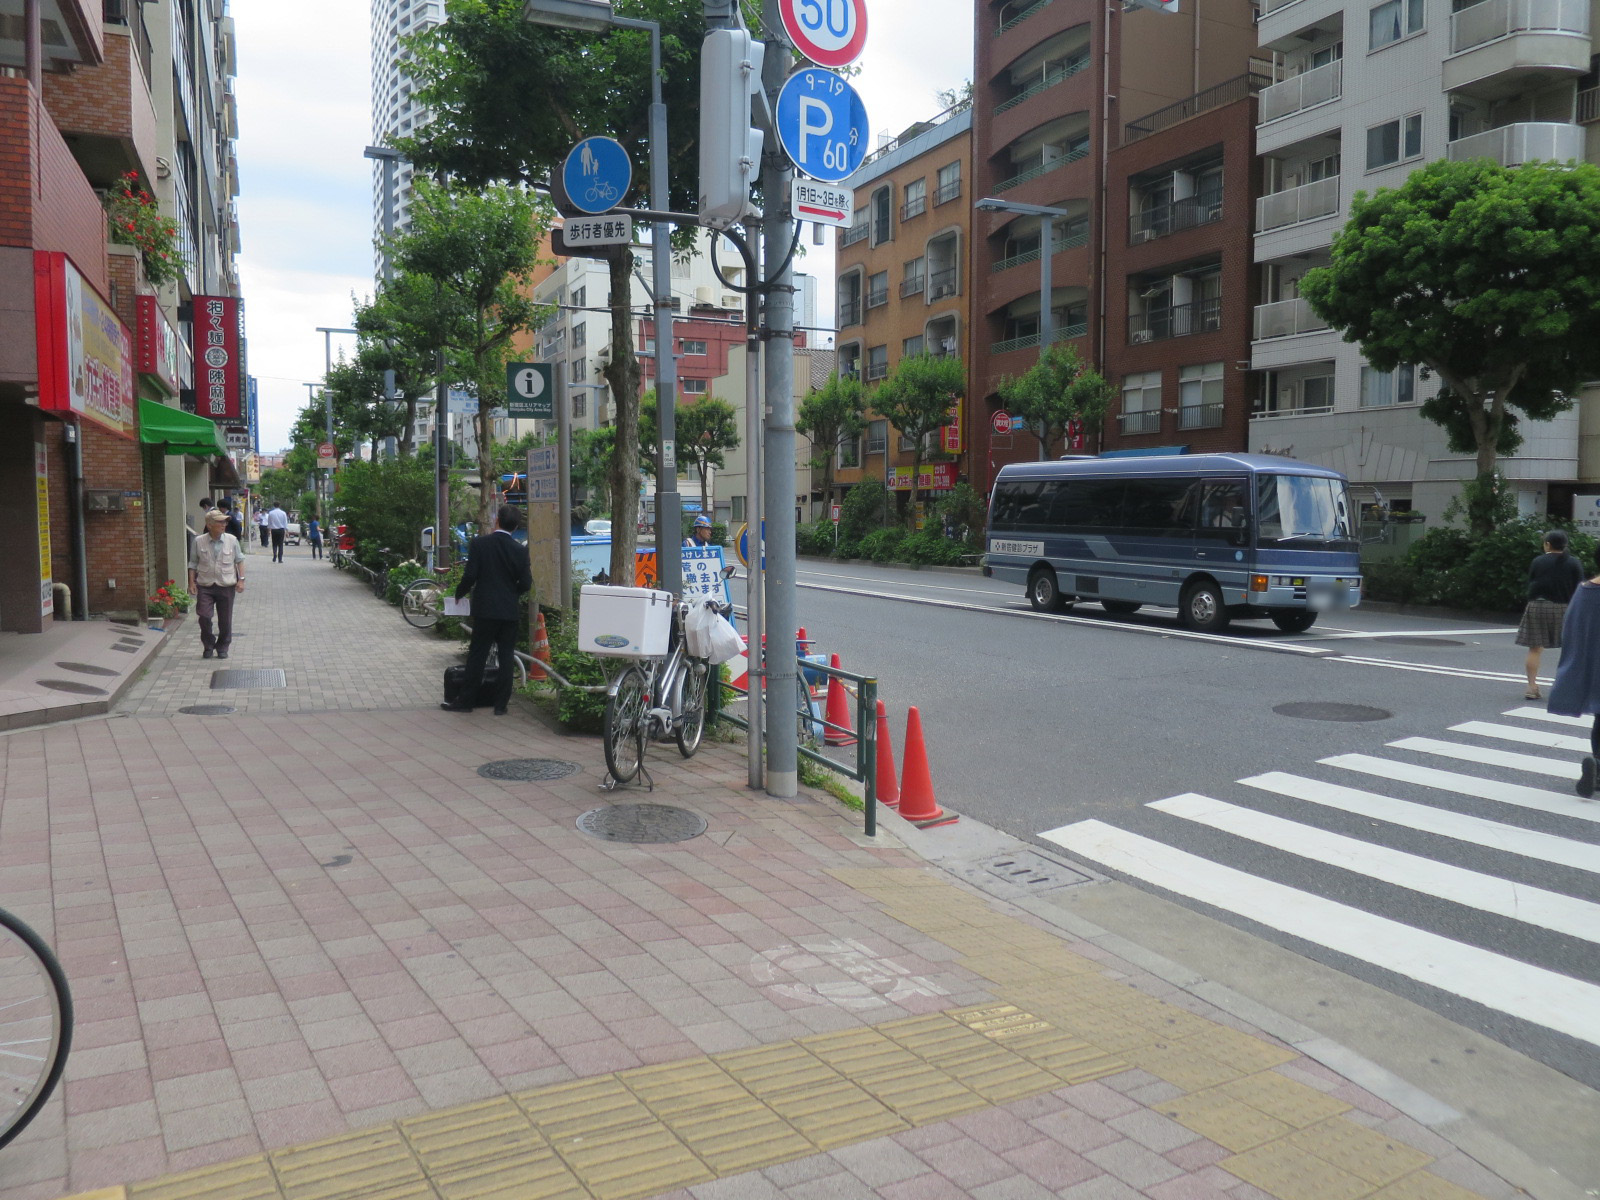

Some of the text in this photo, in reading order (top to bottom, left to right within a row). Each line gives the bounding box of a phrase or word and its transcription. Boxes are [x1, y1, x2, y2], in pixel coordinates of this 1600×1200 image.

[801, 0, 848, 38] 50
[805, 73, 844, 96] 9-19
[799, 95, 834, 164] P
[570, 220, 625, 241] 歩行者優先
[207, 300, 225, 346] 担々麺
[208, 368, 226, 414] 陳麻飯
